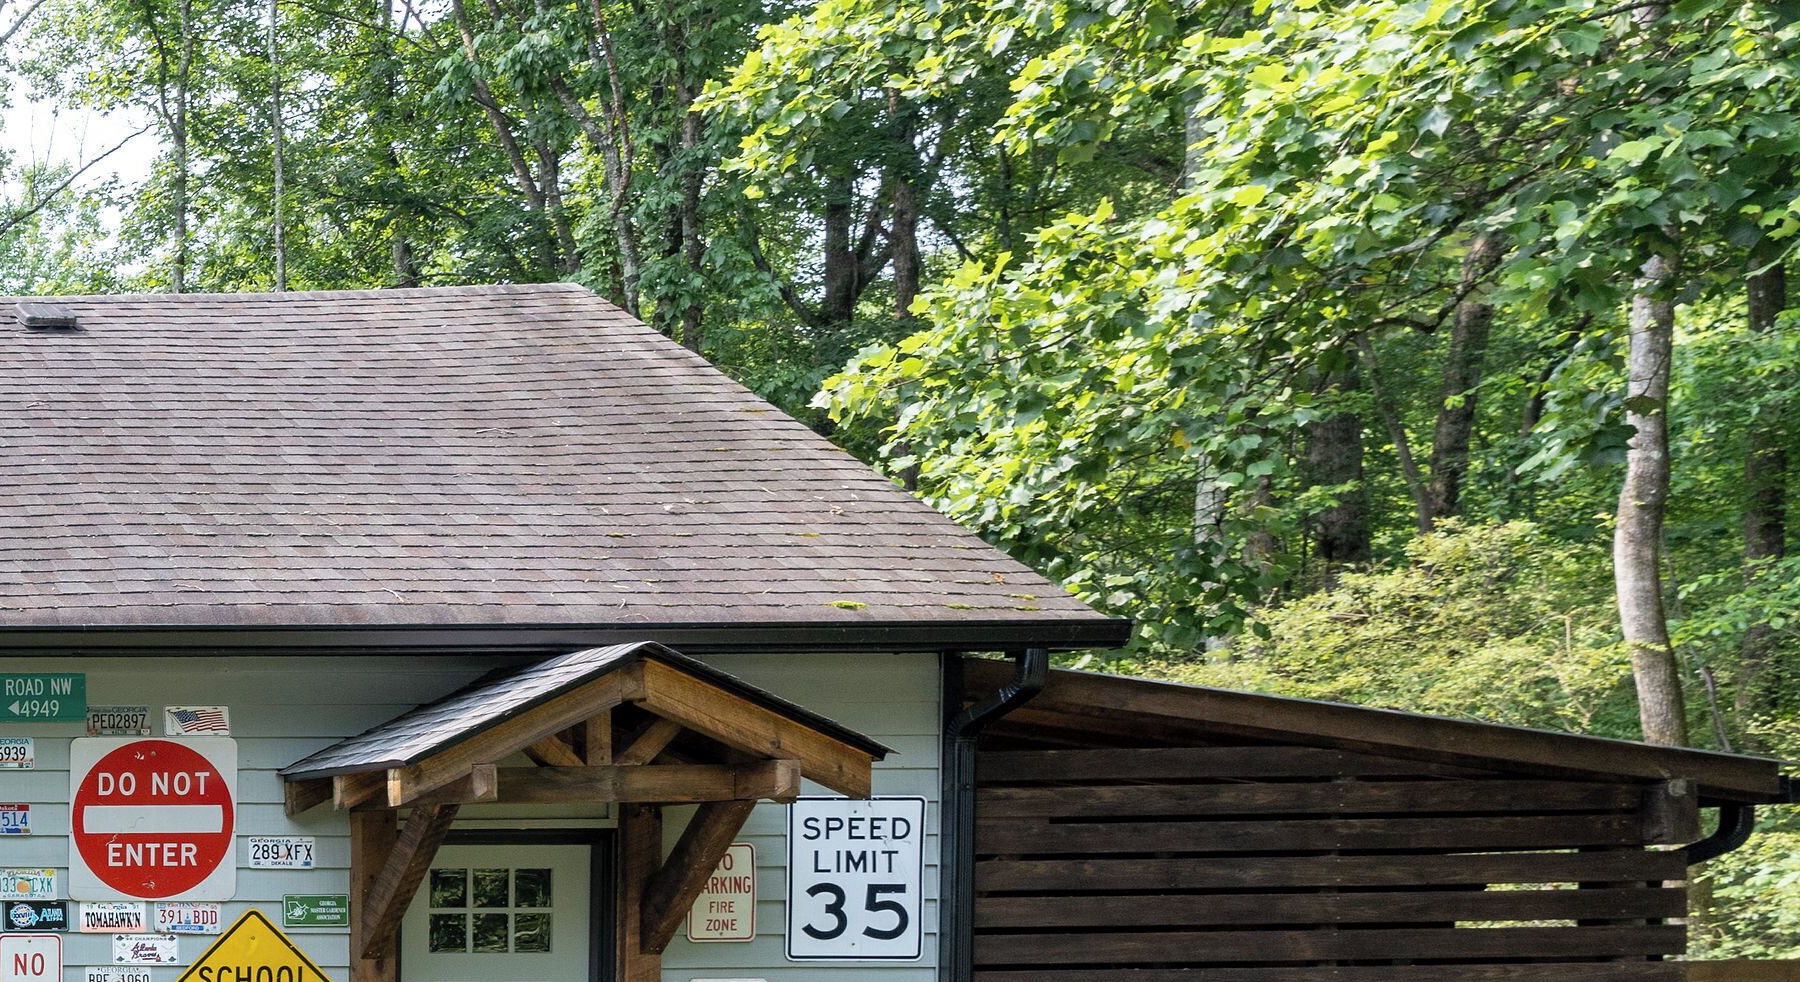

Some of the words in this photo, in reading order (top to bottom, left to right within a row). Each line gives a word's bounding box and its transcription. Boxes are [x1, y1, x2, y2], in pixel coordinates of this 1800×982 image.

[5, 679, 43, 696] ROAD
[51, 678, 72, 695] NW
[20, 700, 60, 716] 4949
[92, 714, 146, 728] PEQ2897
[98, 772, 136, 796] DO
[152, 772, 209, 796] NOT
[2, 812, 28, 826] 514
[802, 817, 910, 840] SPEED
[108, 843, 198, 866] ENTER
[253, 846, 280, 860] 289
[286, 846, 312, 860] XFX
[814, 850, 898, 873] LIMIT
[718, 854, 732, 870] O
[702, 876, 750, 894] ARKING
[710, 902, 734, 913] FIRE
[802, 883, 909, 940] 35
[85, 912, 140, 928] TOMAHAWK'N
[706, 919, 737, 931] ZONE
[14, 954, 44, 976] NO
